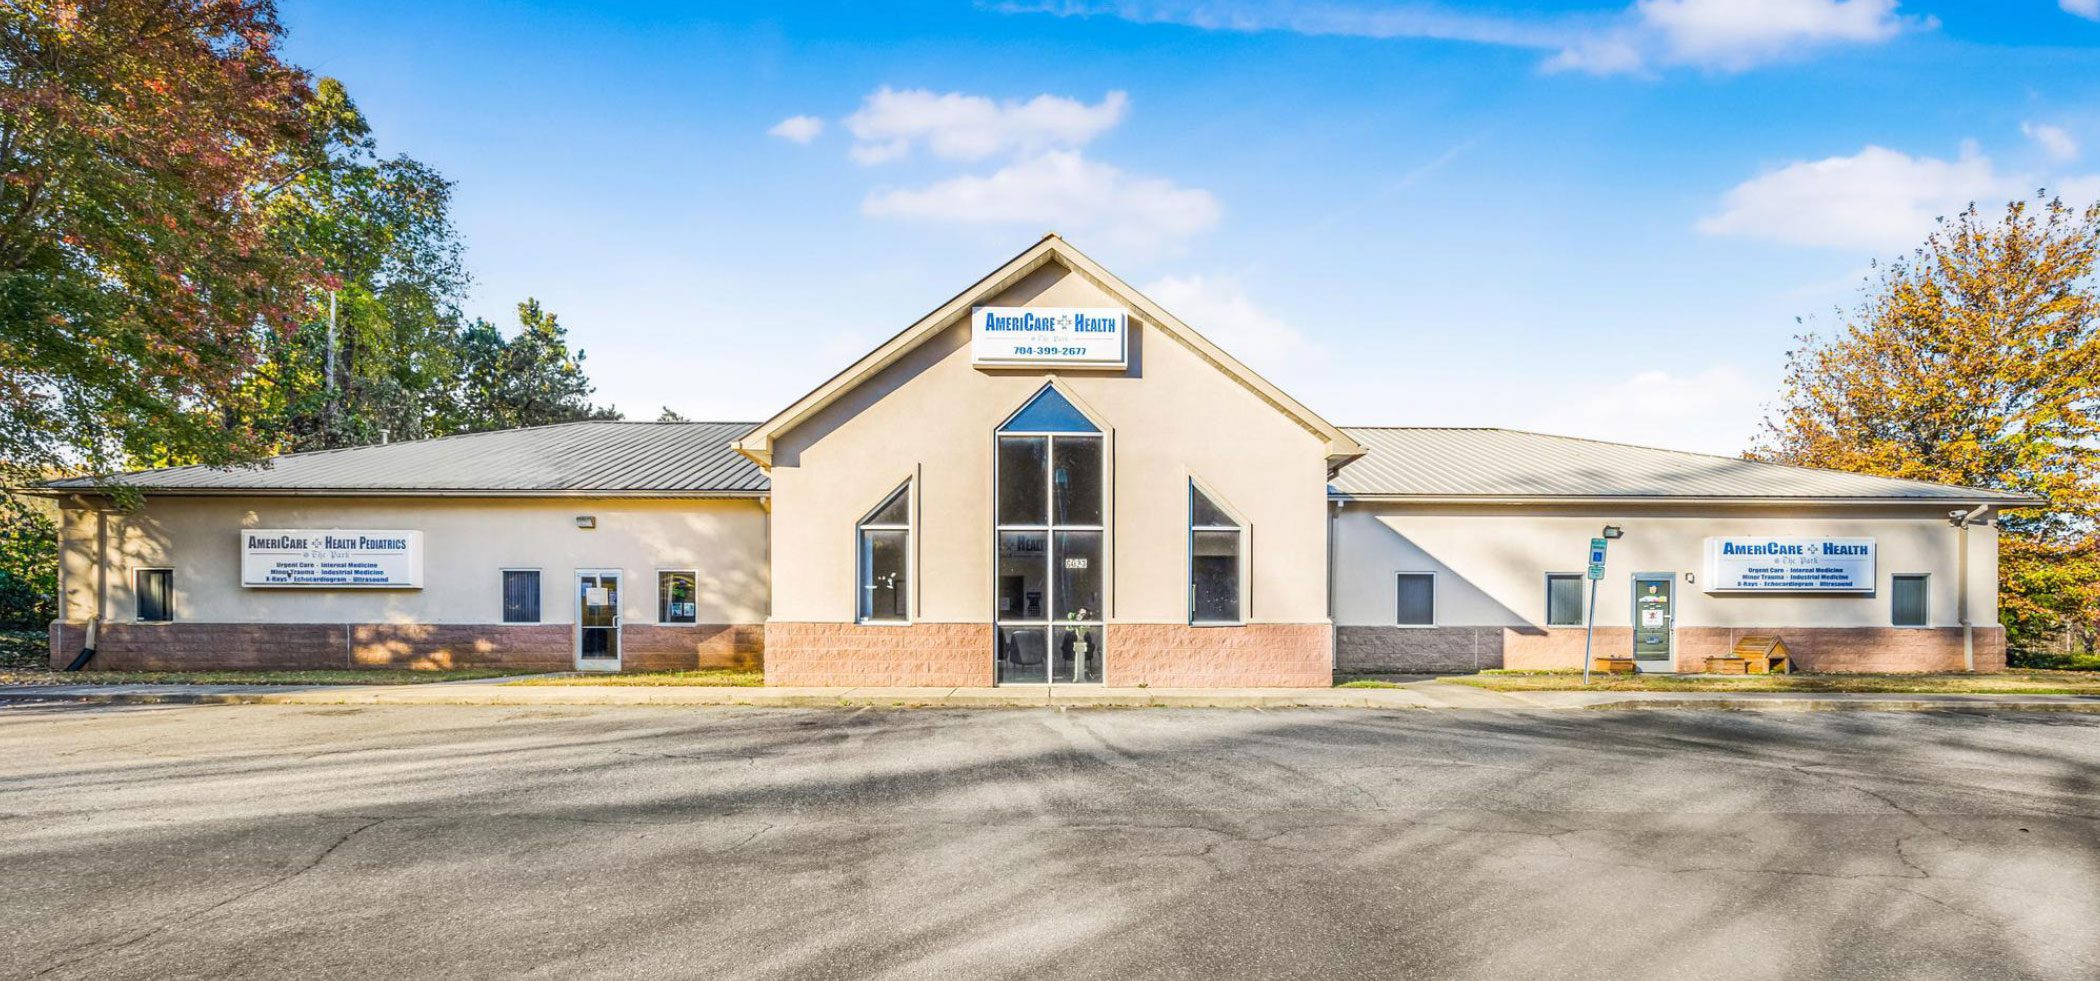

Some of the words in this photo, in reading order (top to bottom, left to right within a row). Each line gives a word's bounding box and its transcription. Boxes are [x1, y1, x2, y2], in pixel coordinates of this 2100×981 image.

[985, 312, 1055, 331] AMERICARE
[1074, 313, 1115, 332] HEALTH
[1014, 346, 1086, 356] 704-399-2677
[248, 535, 308, 549] AMERICARE
[325, 536, 356, 549] HEALTH
[360, 536, 406, 550] PEDIATRICS
[1722, 542, 1803, 555] AMERICARE
[1822, 542, 1868, 555] HEALTH
